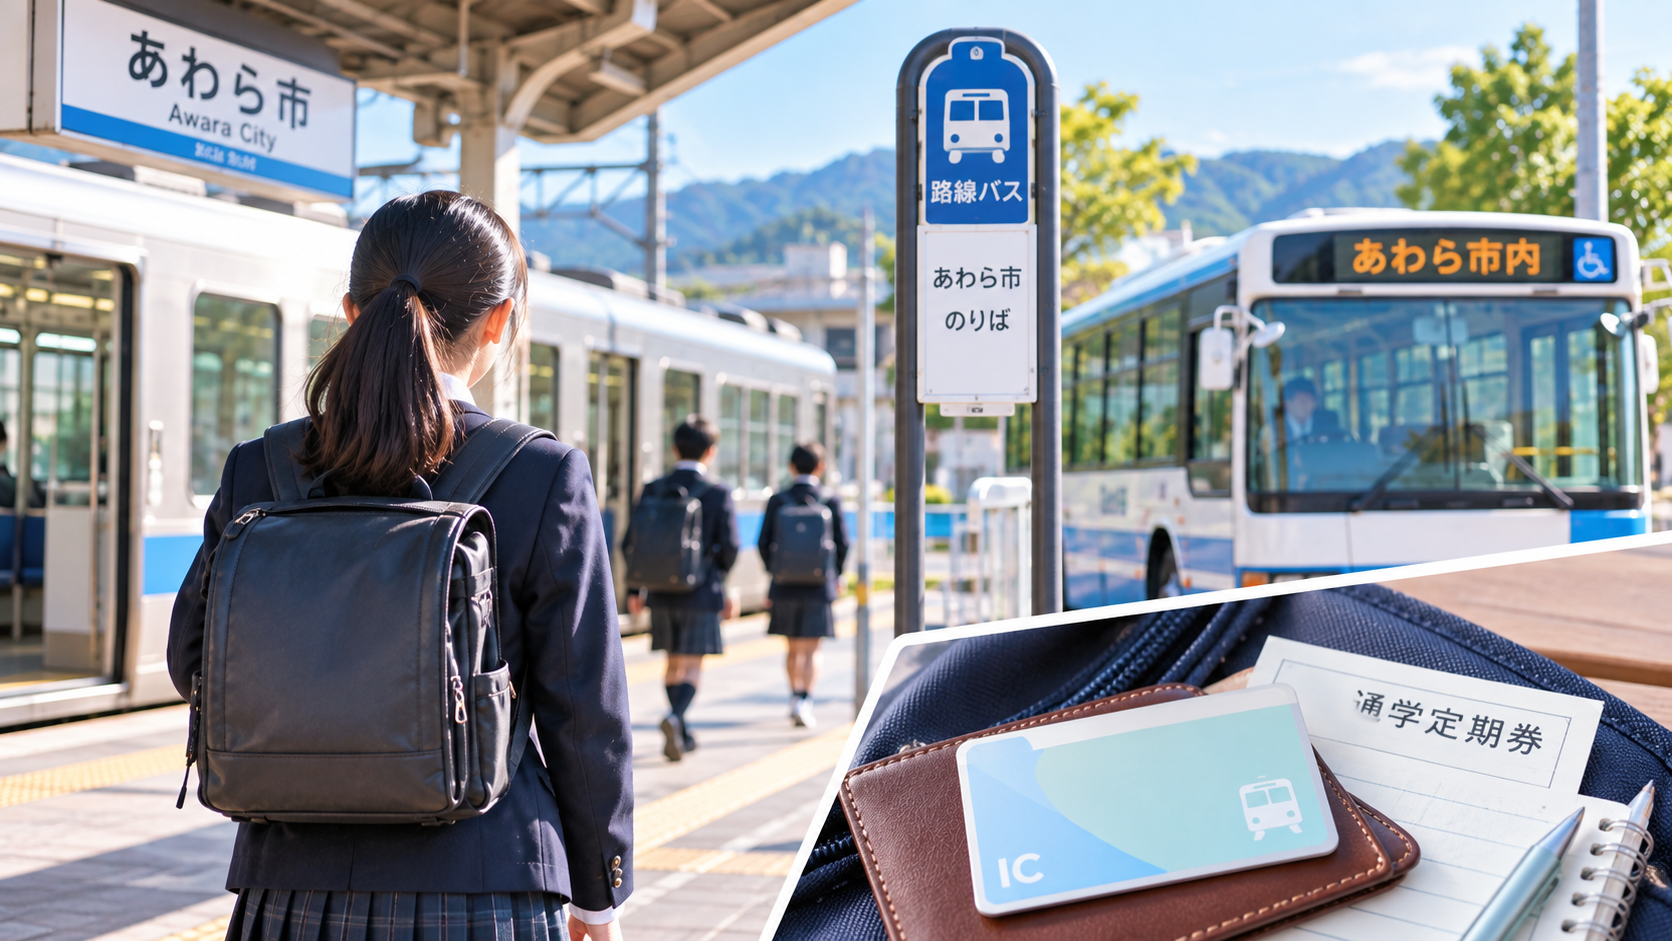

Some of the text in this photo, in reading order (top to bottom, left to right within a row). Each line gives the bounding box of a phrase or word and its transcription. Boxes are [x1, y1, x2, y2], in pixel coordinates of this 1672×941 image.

[129, 30, 312, 130] あわら市
[169, 103, 278, 153] Awara City
[930, 179, 1023, 205] 路線バス
[1352, 236, 1541, 276] あわら市内
[933, 266, 1022, 290] あわら市
[945, 307, 1011, 332] のりば
[997, 852, 1045, 888] IC
